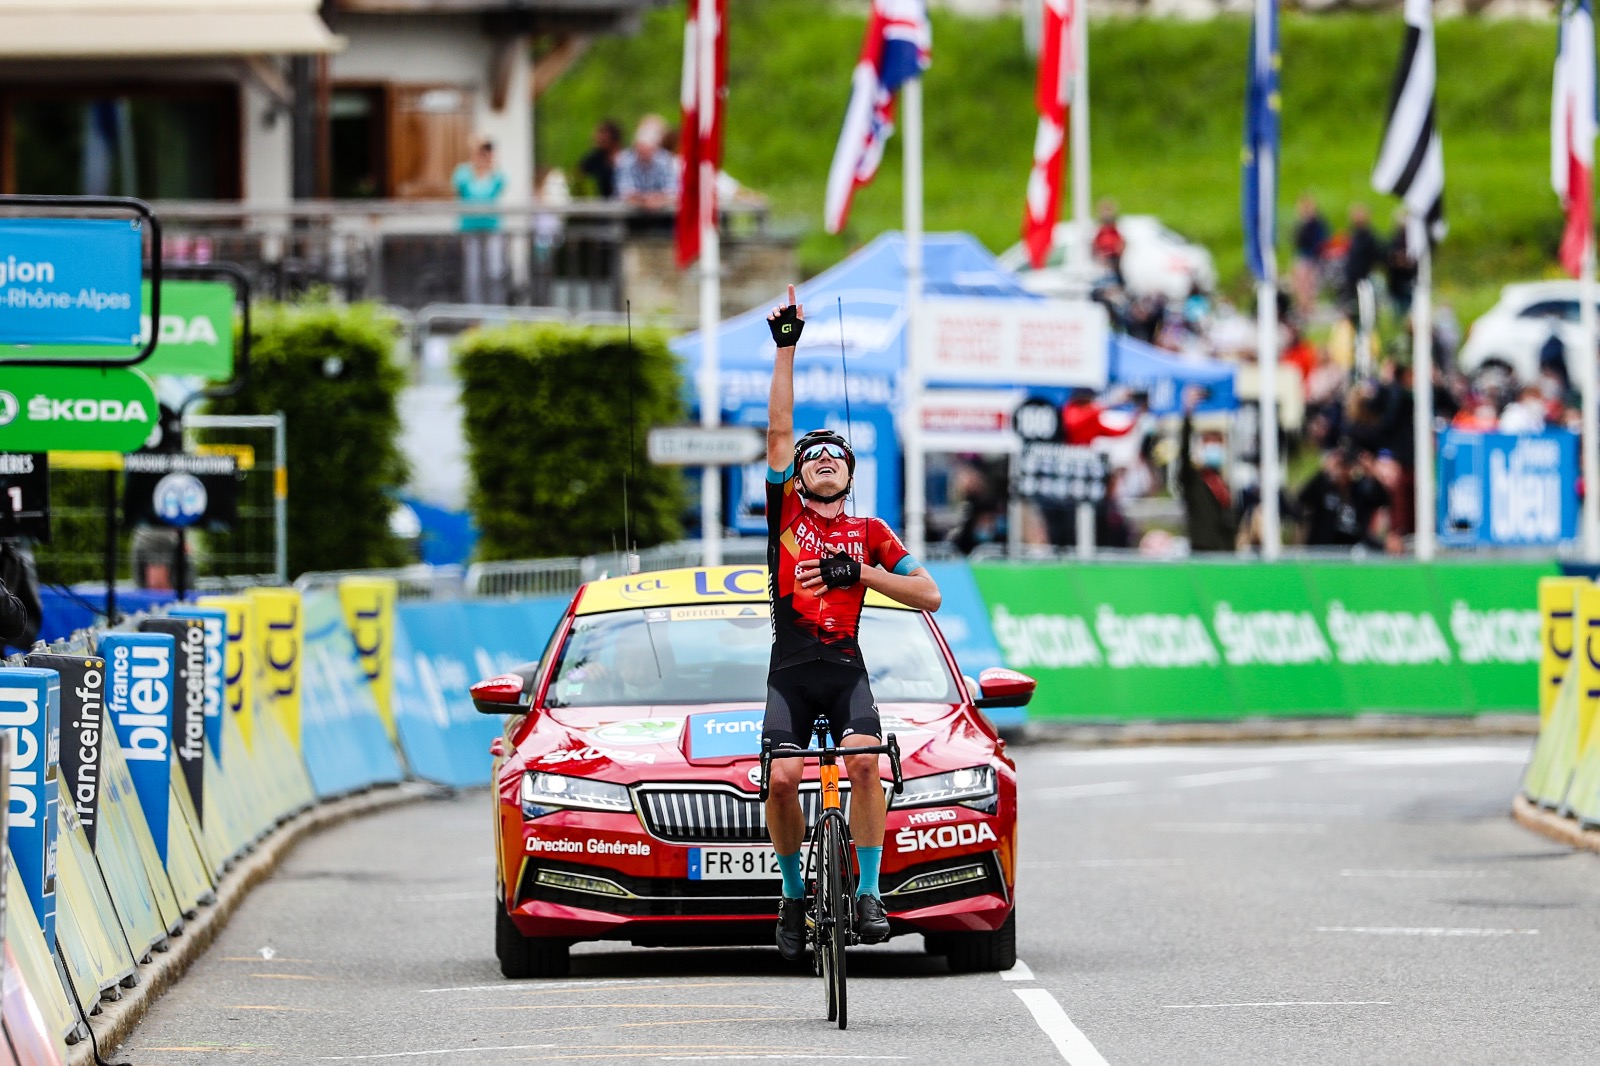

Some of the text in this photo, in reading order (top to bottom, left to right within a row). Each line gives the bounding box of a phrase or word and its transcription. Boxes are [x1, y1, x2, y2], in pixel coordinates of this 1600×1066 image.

[27, 394, 148, 422] ŠKODA
[7, 486, 22, 512] 1
[794, 534, 865, 563] VICTORUS
[624, 579, 670, 593] LCL
[694, 569, 765, 596] LC
[677, 608, 727, 619] OFFICIEL
[109, 646, 129, 712] france
[119, 646, 170, 762] bleu
[703, 719, 763, 735] franc
[908, 809, 957, 825] HYBRID
[525, 836, 651, 856] Direction Générale
[895, 821, 997, 853] ŠKODA
[705, 851, 817, 874] FR-812Q
